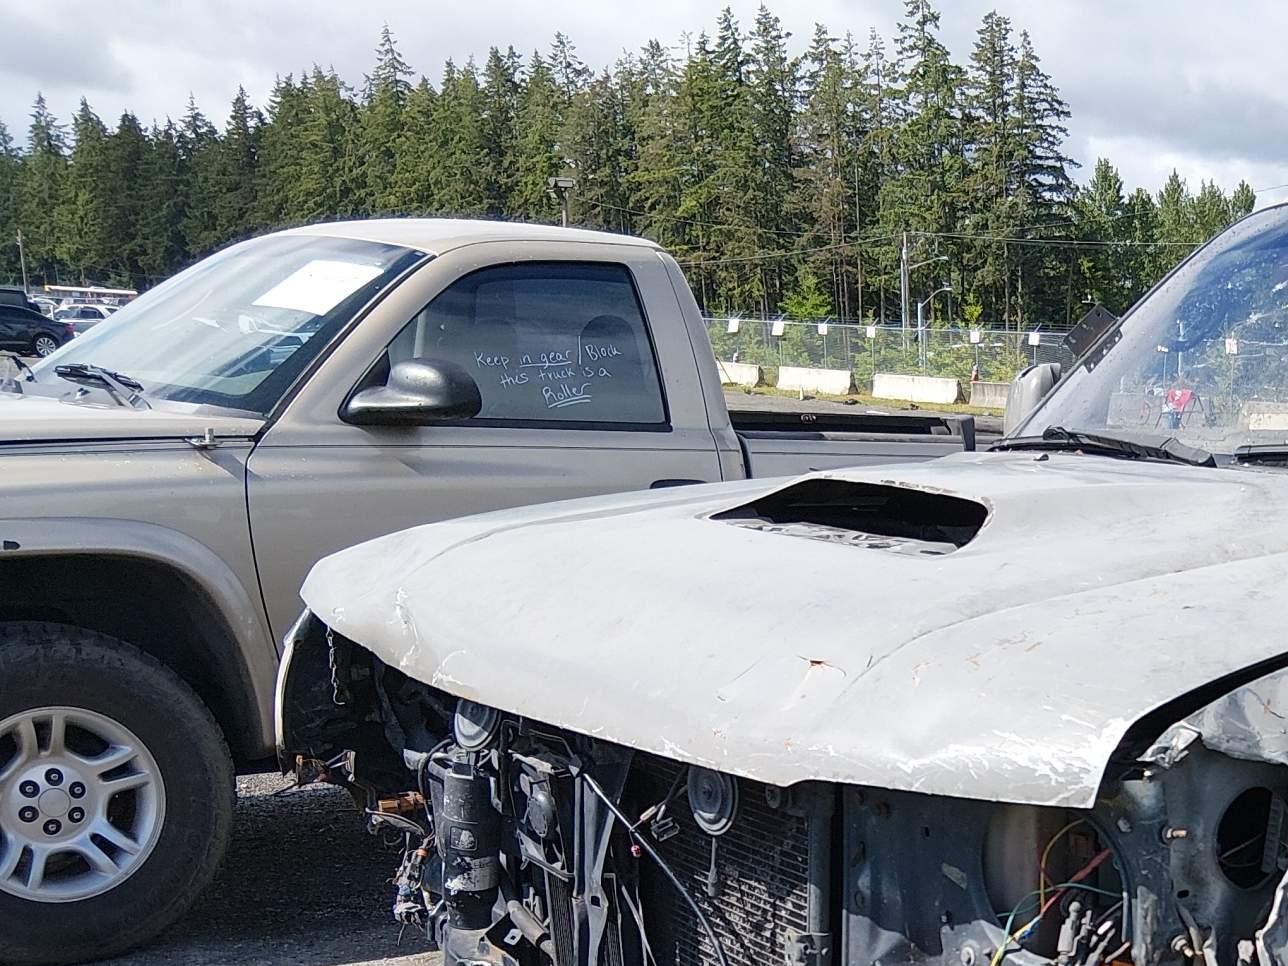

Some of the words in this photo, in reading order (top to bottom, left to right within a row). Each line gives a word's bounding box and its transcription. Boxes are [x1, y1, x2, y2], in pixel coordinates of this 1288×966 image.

[474, 352, 509, 368] Keep
[520, 354, 531, 366] in
[500, 370, 529, 388] this
[539, 367, 576, 381] truck
[583, 367, 594, 377] is
[598, 367, 611, 377] a
[542, 383, 592, 405] Roller
